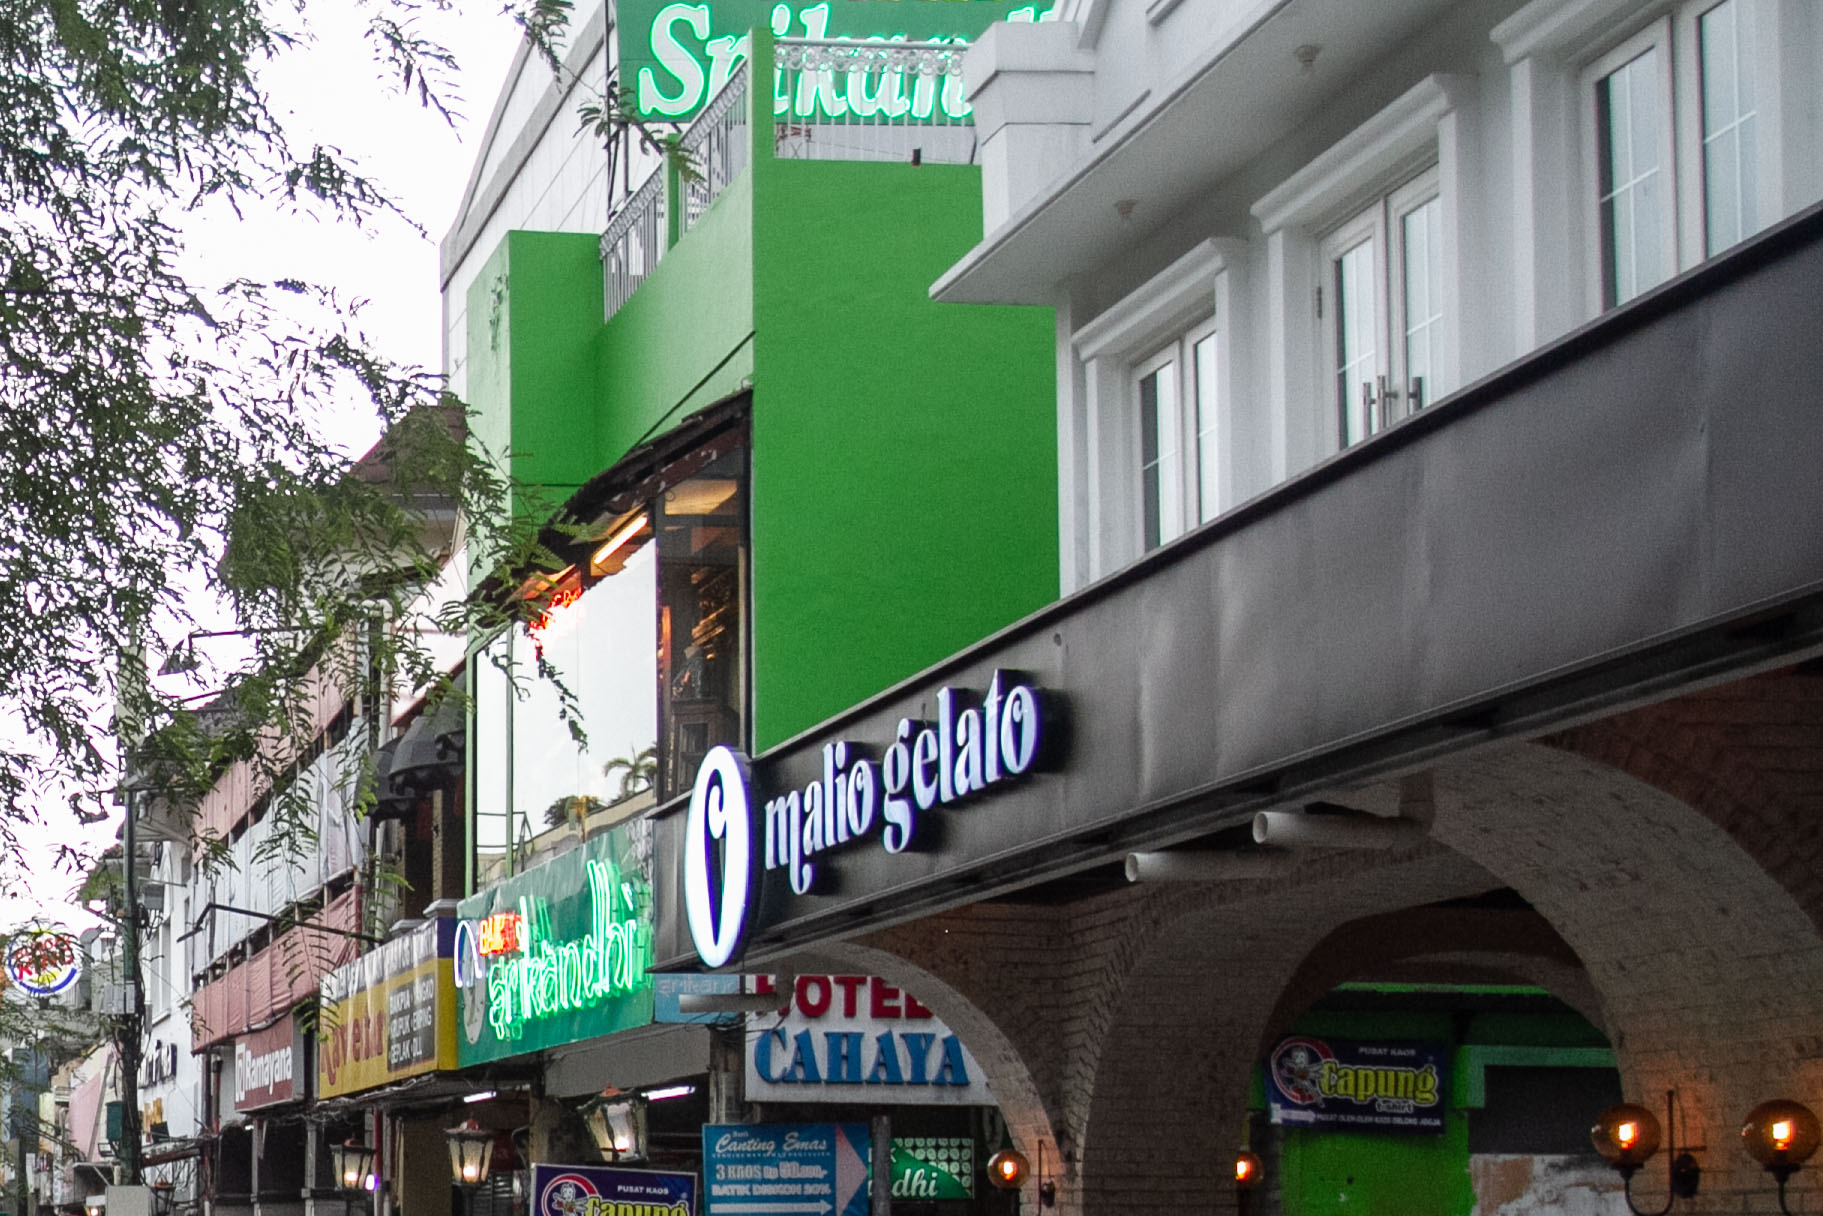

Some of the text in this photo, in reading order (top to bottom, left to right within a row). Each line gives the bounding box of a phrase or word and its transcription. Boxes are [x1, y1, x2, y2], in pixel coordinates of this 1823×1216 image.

[765, 669, 1039, 896] malio gelato
[245, 1046, 292, 1096] Ramayana
[754, 1027, 970, 1087] CAHAYA
[715, 1131, 827, 1156] Canting Emas
[617, 1184, 670, 1196] PUSAT KAOS
[715, 1163, 726, 1180] 3
